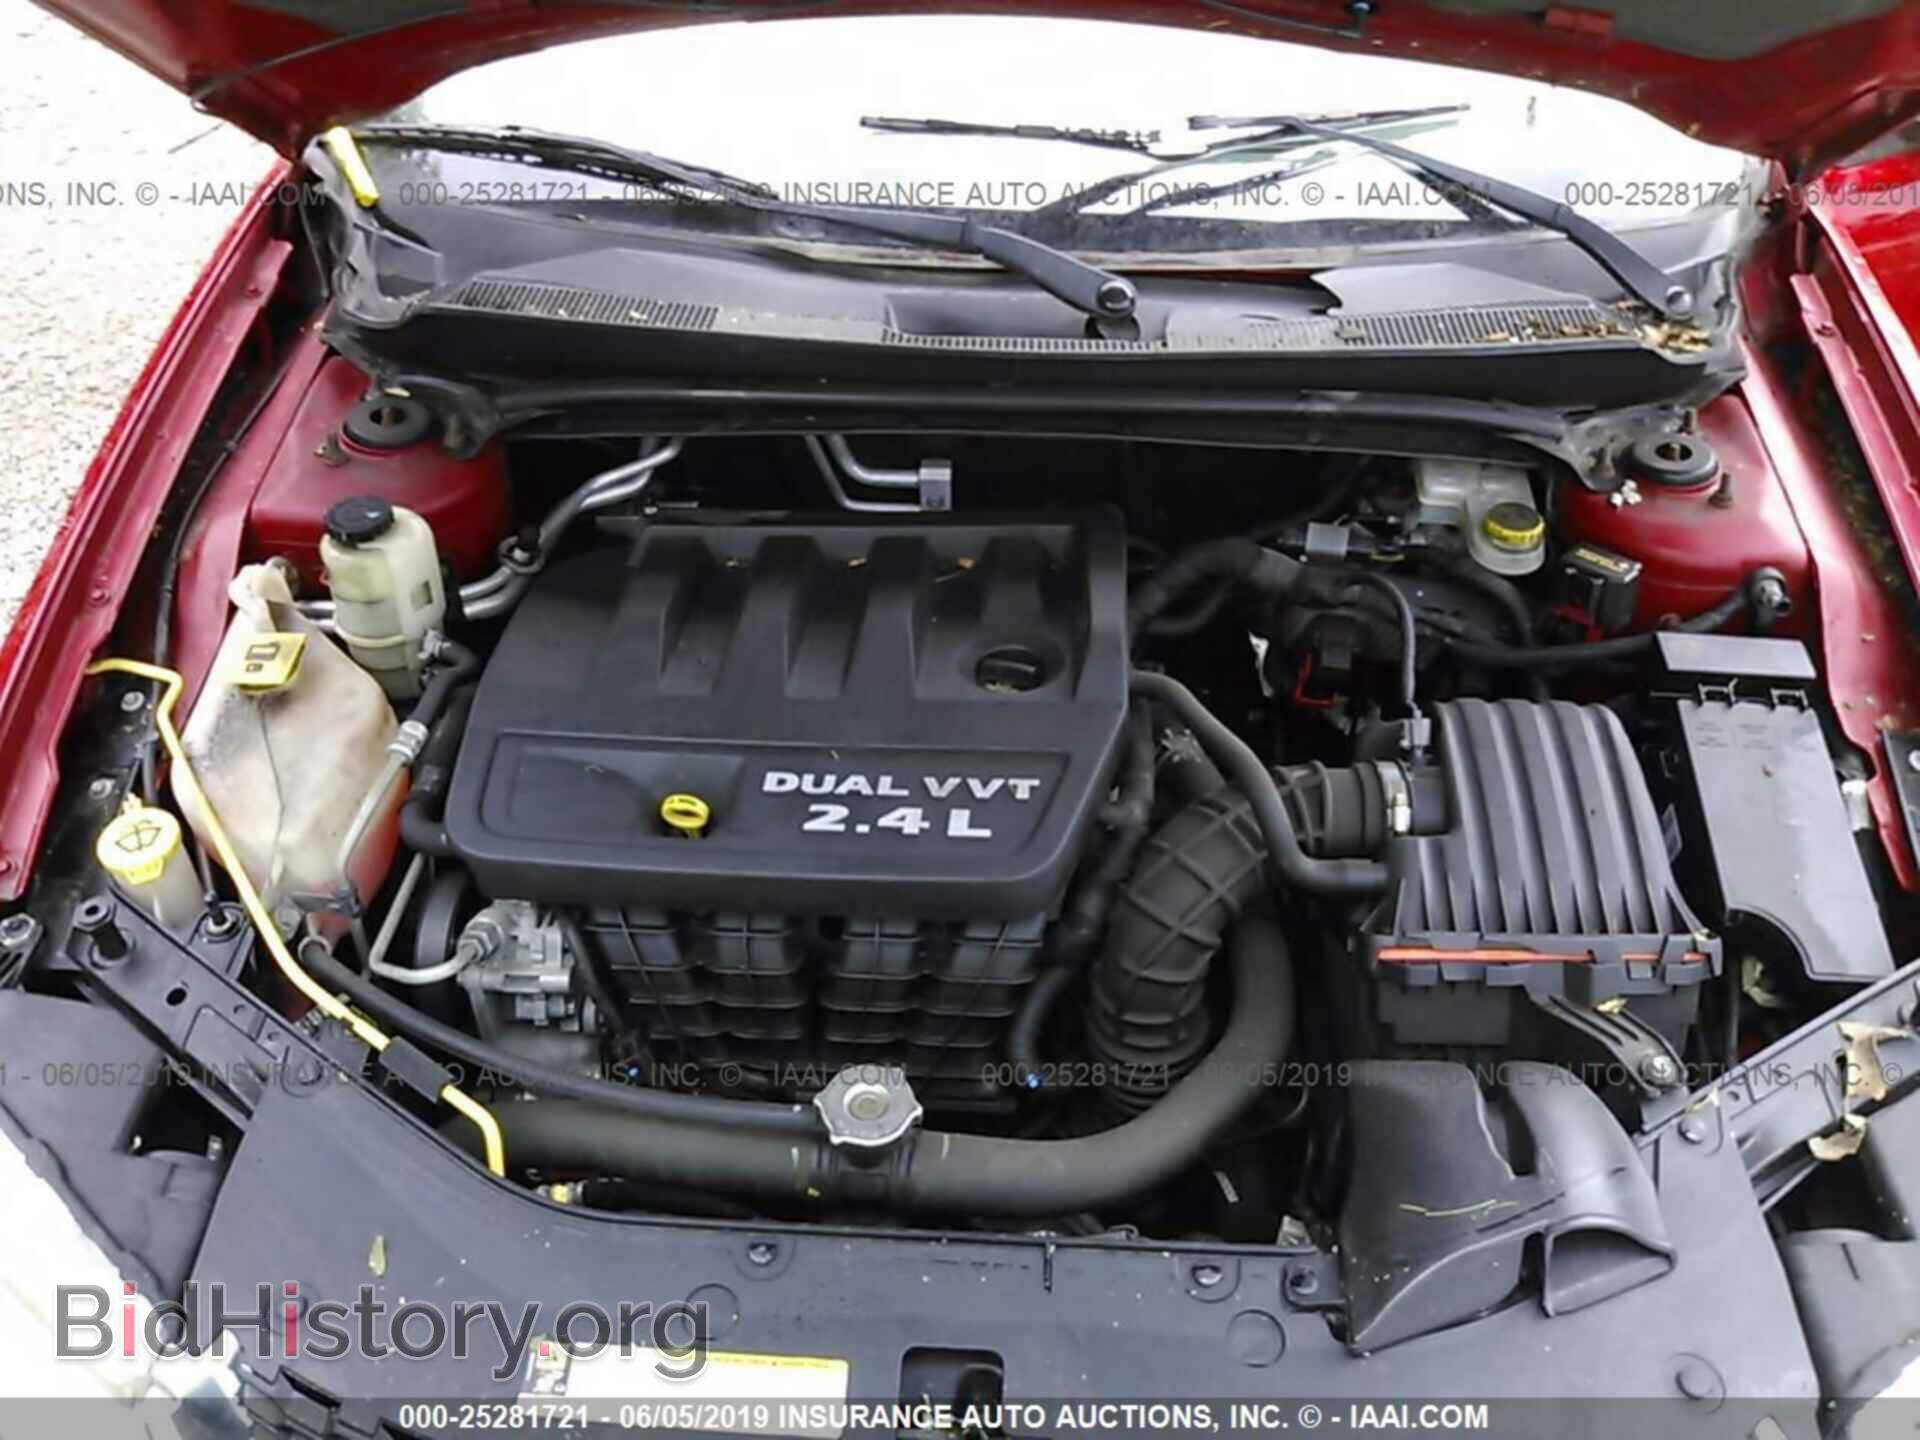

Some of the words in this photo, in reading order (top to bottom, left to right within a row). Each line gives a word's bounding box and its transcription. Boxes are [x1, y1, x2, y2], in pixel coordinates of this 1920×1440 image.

[762, 771, 910, 796] DUAL
[923, 776, 1041, 800] VVT
[802, 804, 931, 836] 2.4
[946, 808, 993, 839] L
